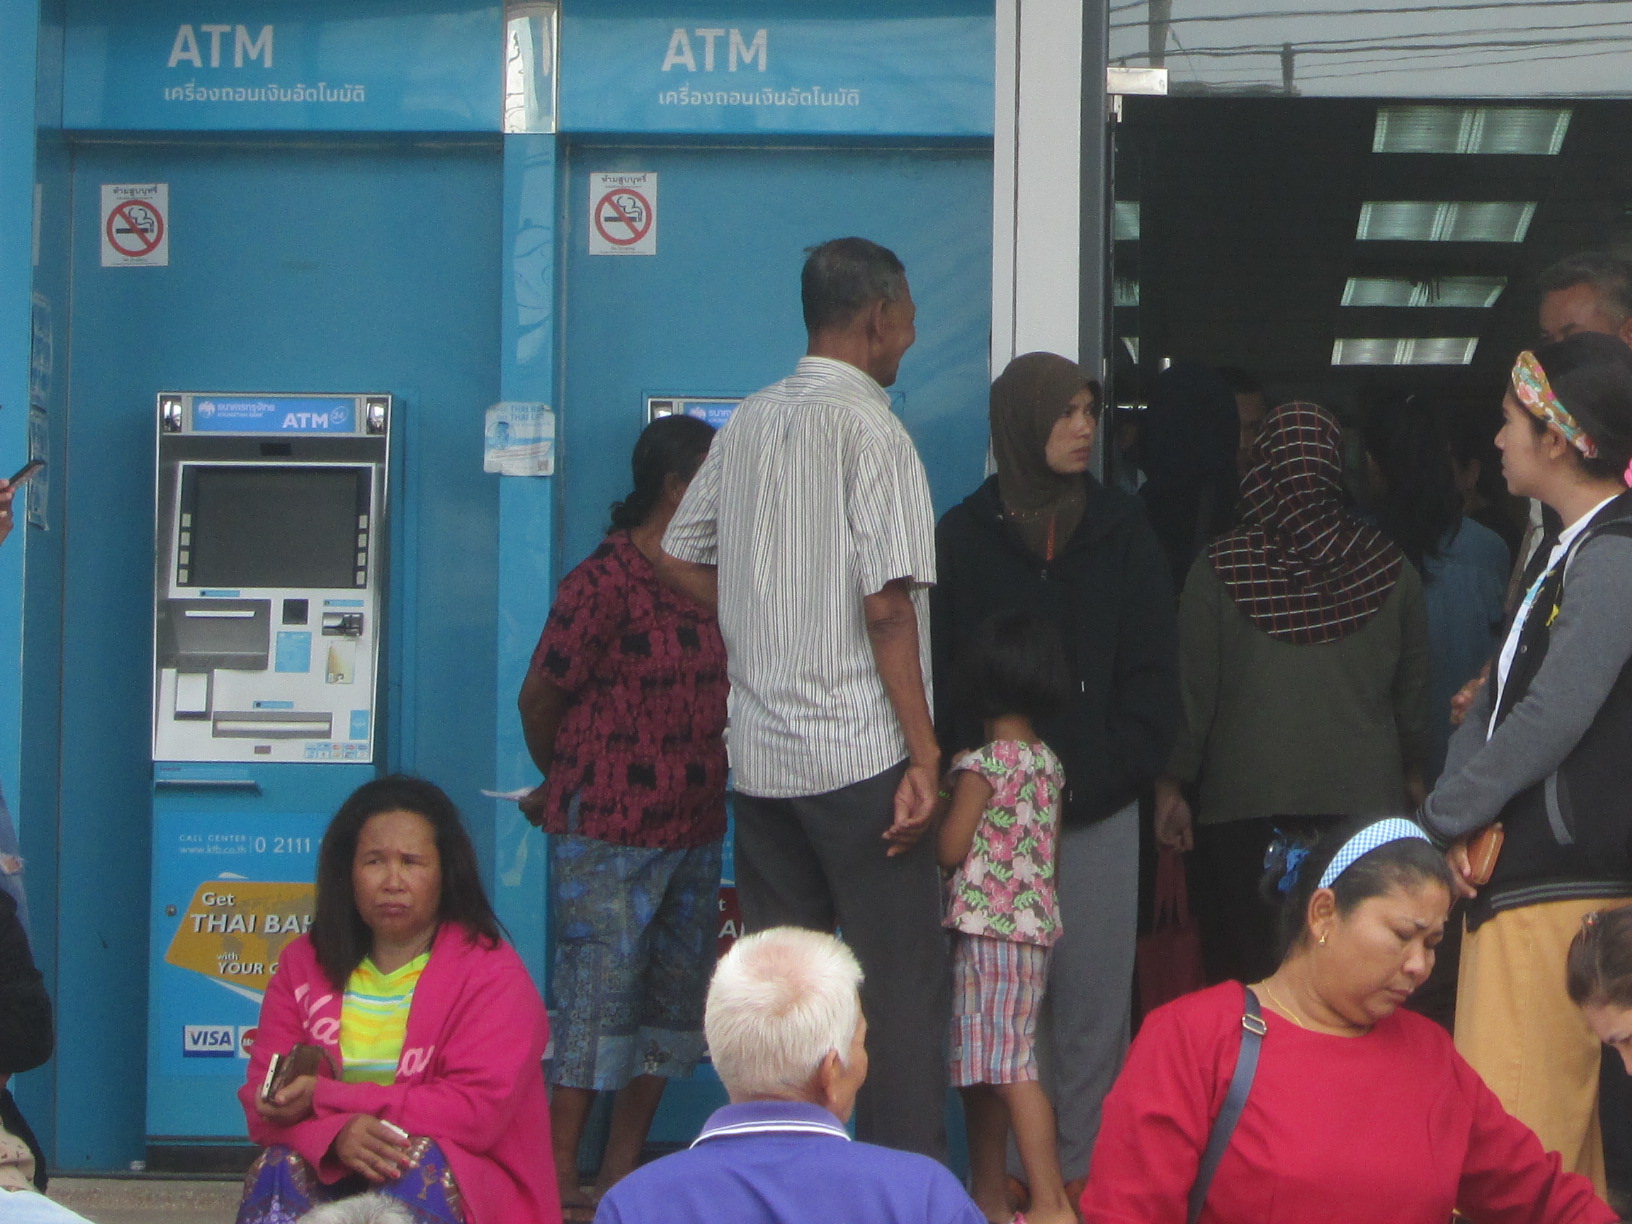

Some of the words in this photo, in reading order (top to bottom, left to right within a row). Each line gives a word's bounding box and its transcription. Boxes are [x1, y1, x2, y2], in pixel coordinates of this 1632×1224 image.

[168, 25, 274, 68] ATM
[661, 29, 768, 72] ATM
[164, 79, 366, 103] เครื่องถอนเงินอัตโนมัติ
[658, 82, 861, 106] เครื่องถอนเงินอัตโนมัติ
[282, 412, 329, 428] ATM
[179, 834, 202, 842] CALL
[208, 834, 246, 842] CENTER
[201, 892, 235, 906] Get
[190, 913, 257, 934] THAI
[217, 951, 239, 961] with
[219, 962, 266, 975] YOUR
[190, 1030, 232, 1047] VISA
